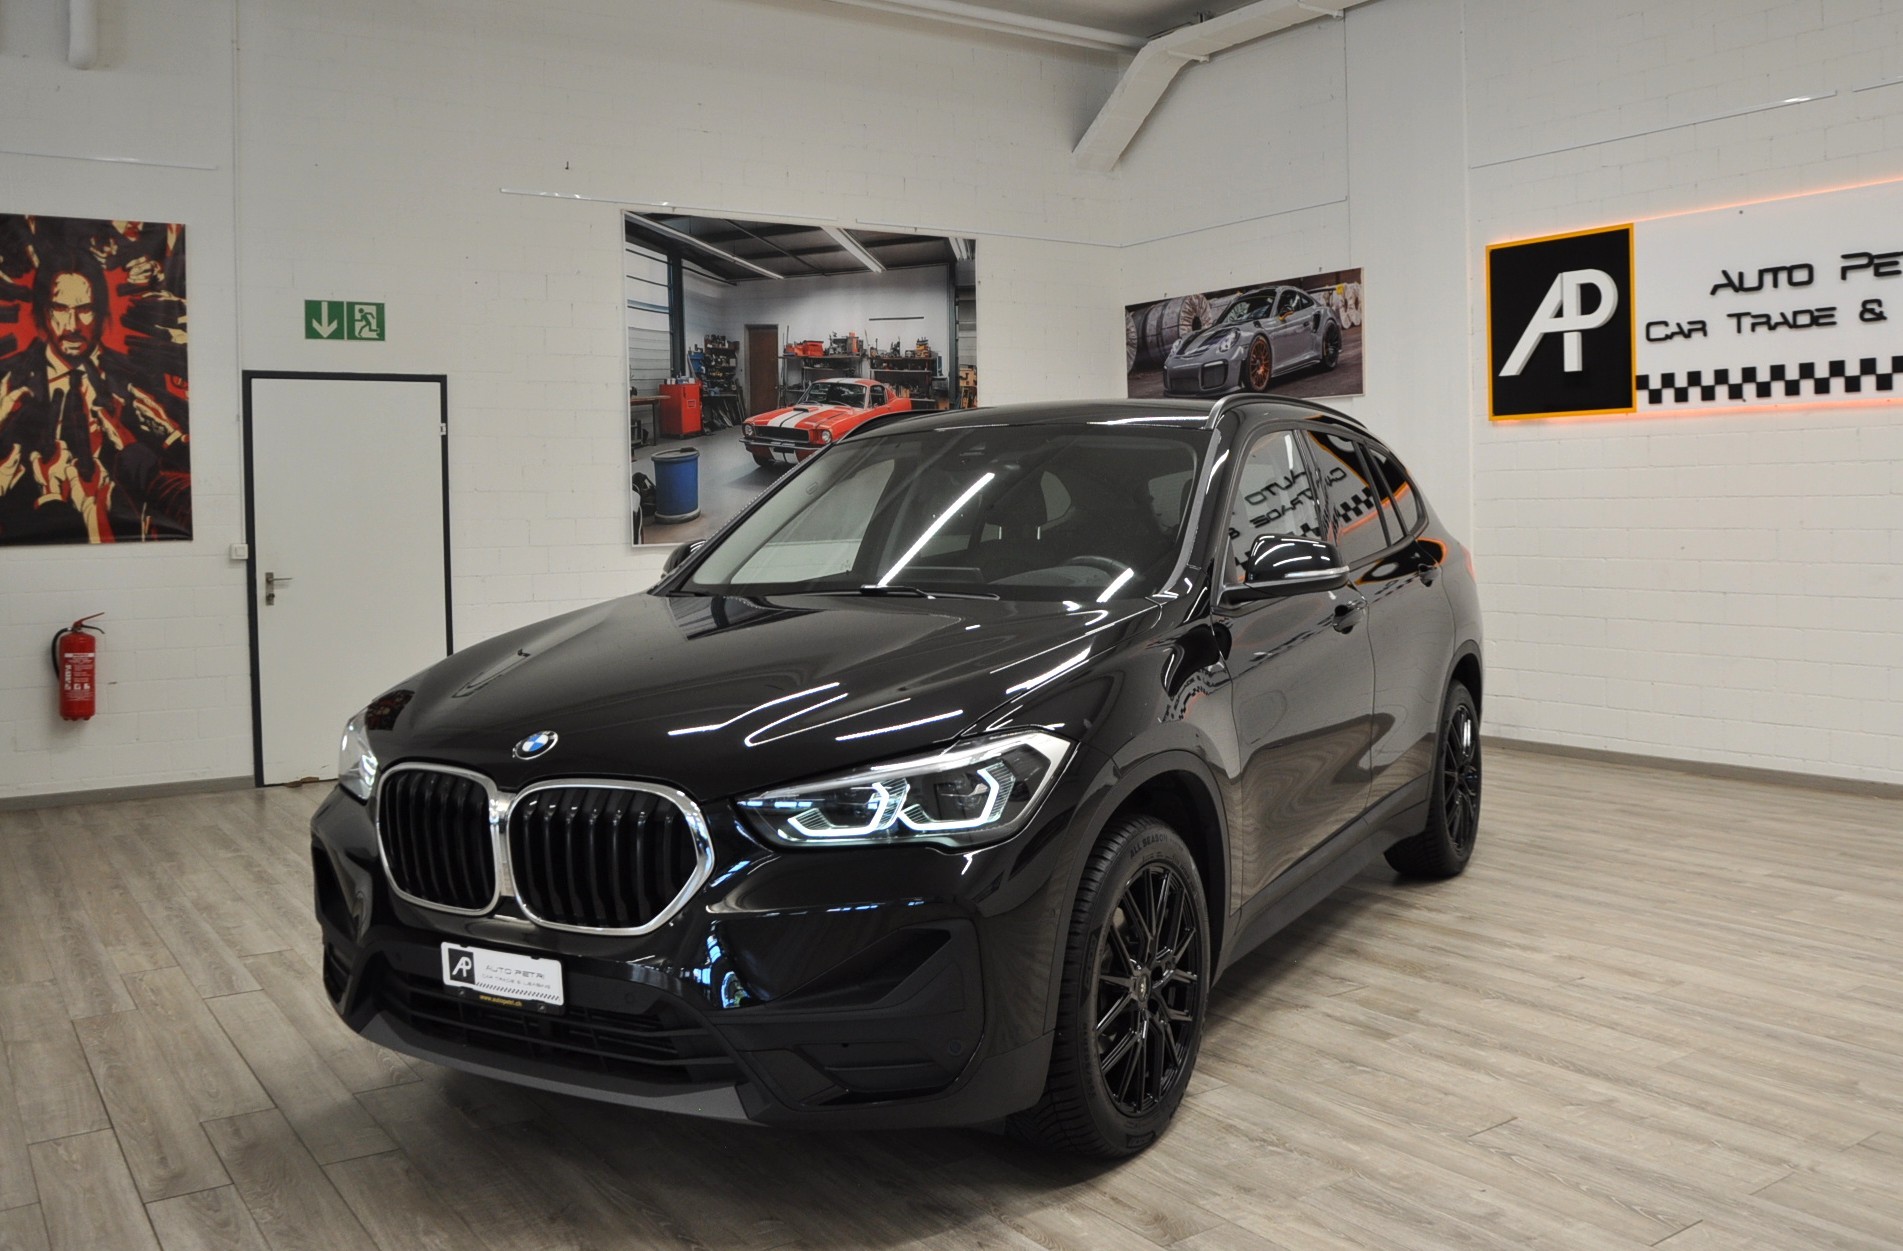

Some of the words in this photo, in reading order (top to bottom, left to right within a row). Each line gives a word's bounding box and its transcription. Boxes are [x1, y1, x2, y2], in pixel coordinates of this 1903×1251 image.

[1709, 263, 1815, 296] AUTO
[1840, 251, 1903, 281] PE
[1498, 268, 1619, 377] AP
[1645, 319, 1708, 343] CAR
[1726, 306, 1837, 334] TRADE
[1858, 298, 1888, 322] &
[485, 965, 512, 976] AUTO
